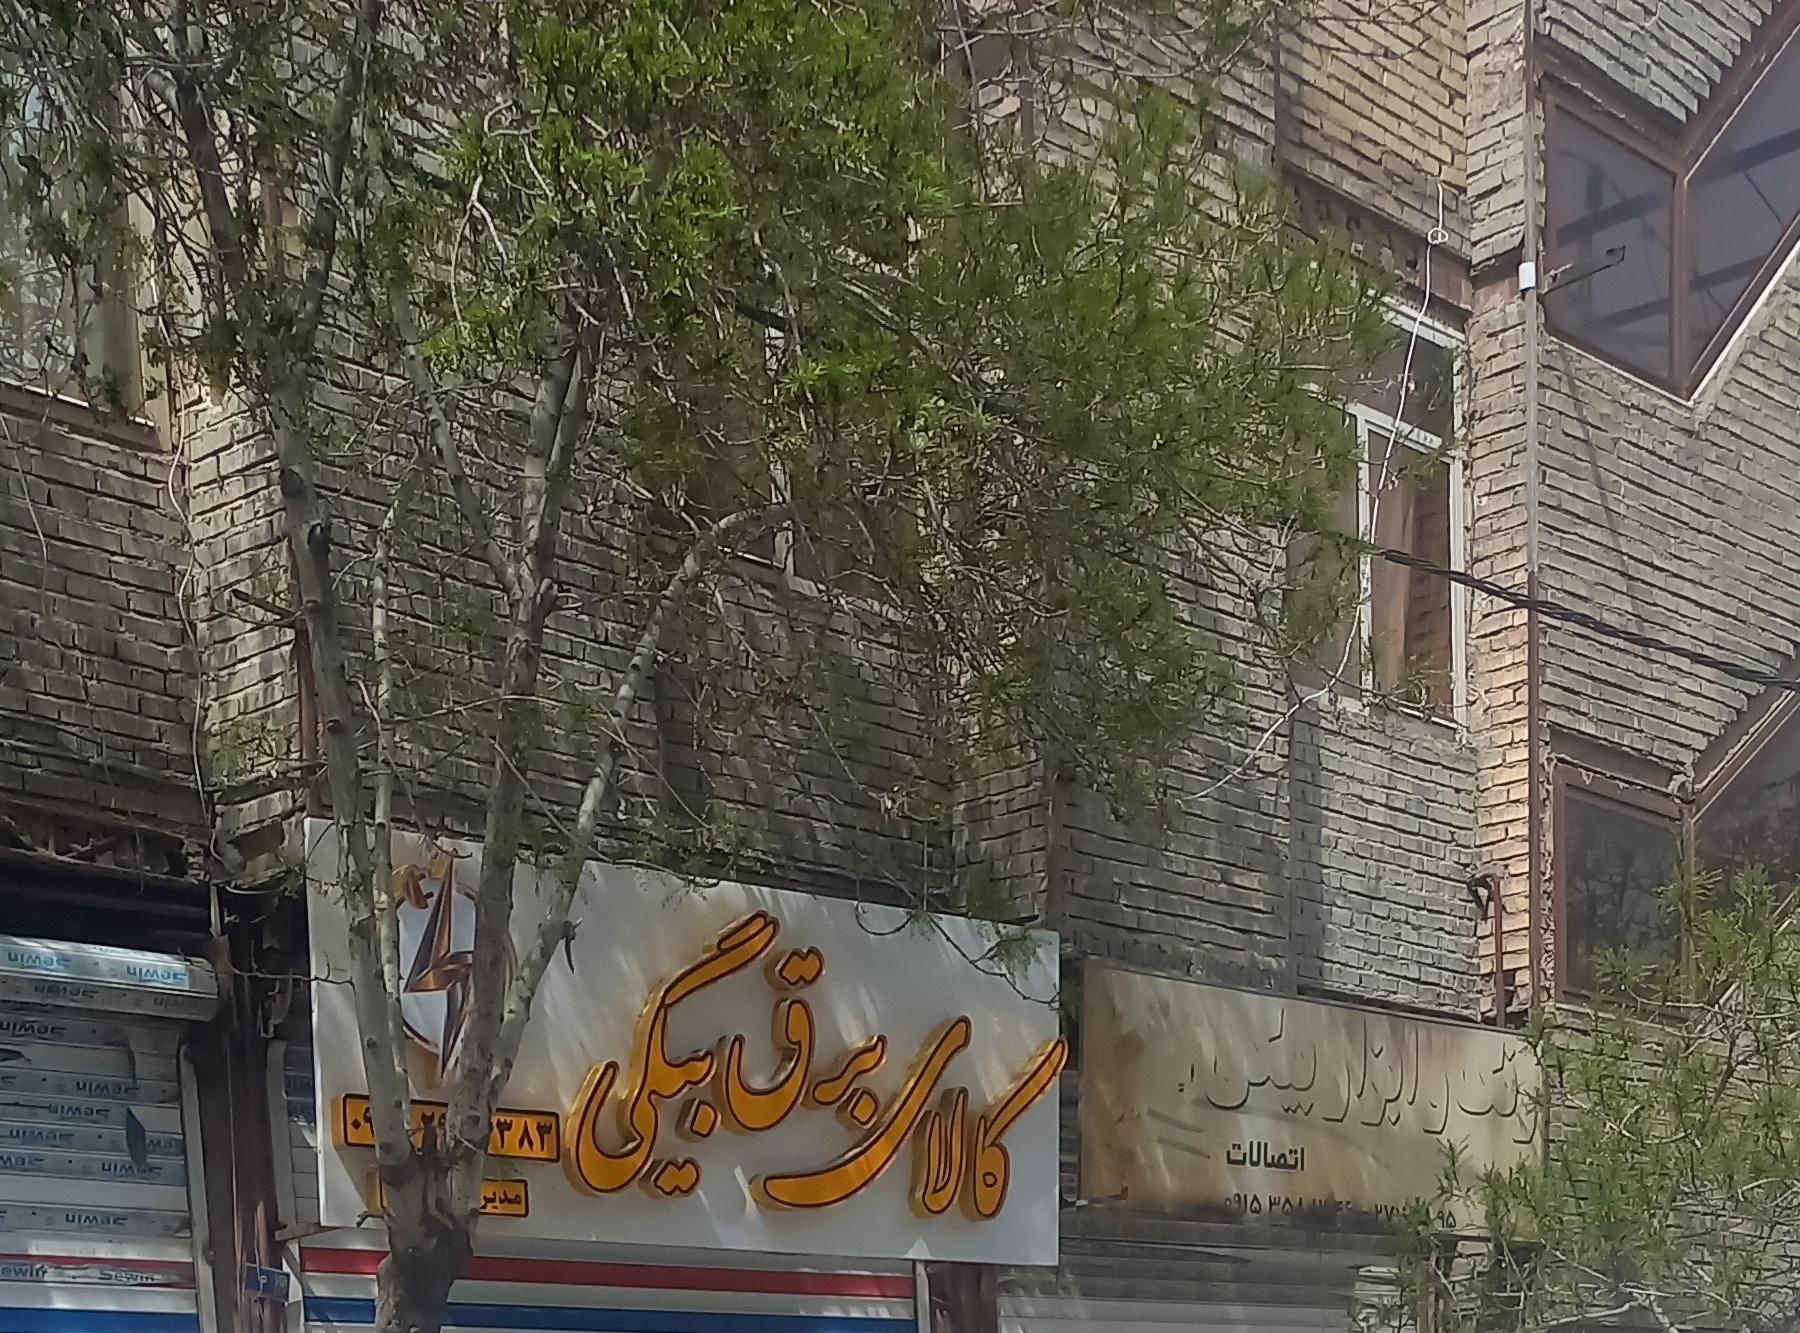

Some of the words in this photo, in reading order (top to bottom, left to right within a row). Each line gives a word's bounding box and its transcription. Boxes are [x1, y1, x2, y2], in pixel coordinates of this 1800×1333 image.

[564, 911, 779, 1198] بیگی
[719, 946, 887, 1132] برق
[752, 1016, 1067, 1222] کالای
[1226, 1140, 1305, 1173] اتصالات
